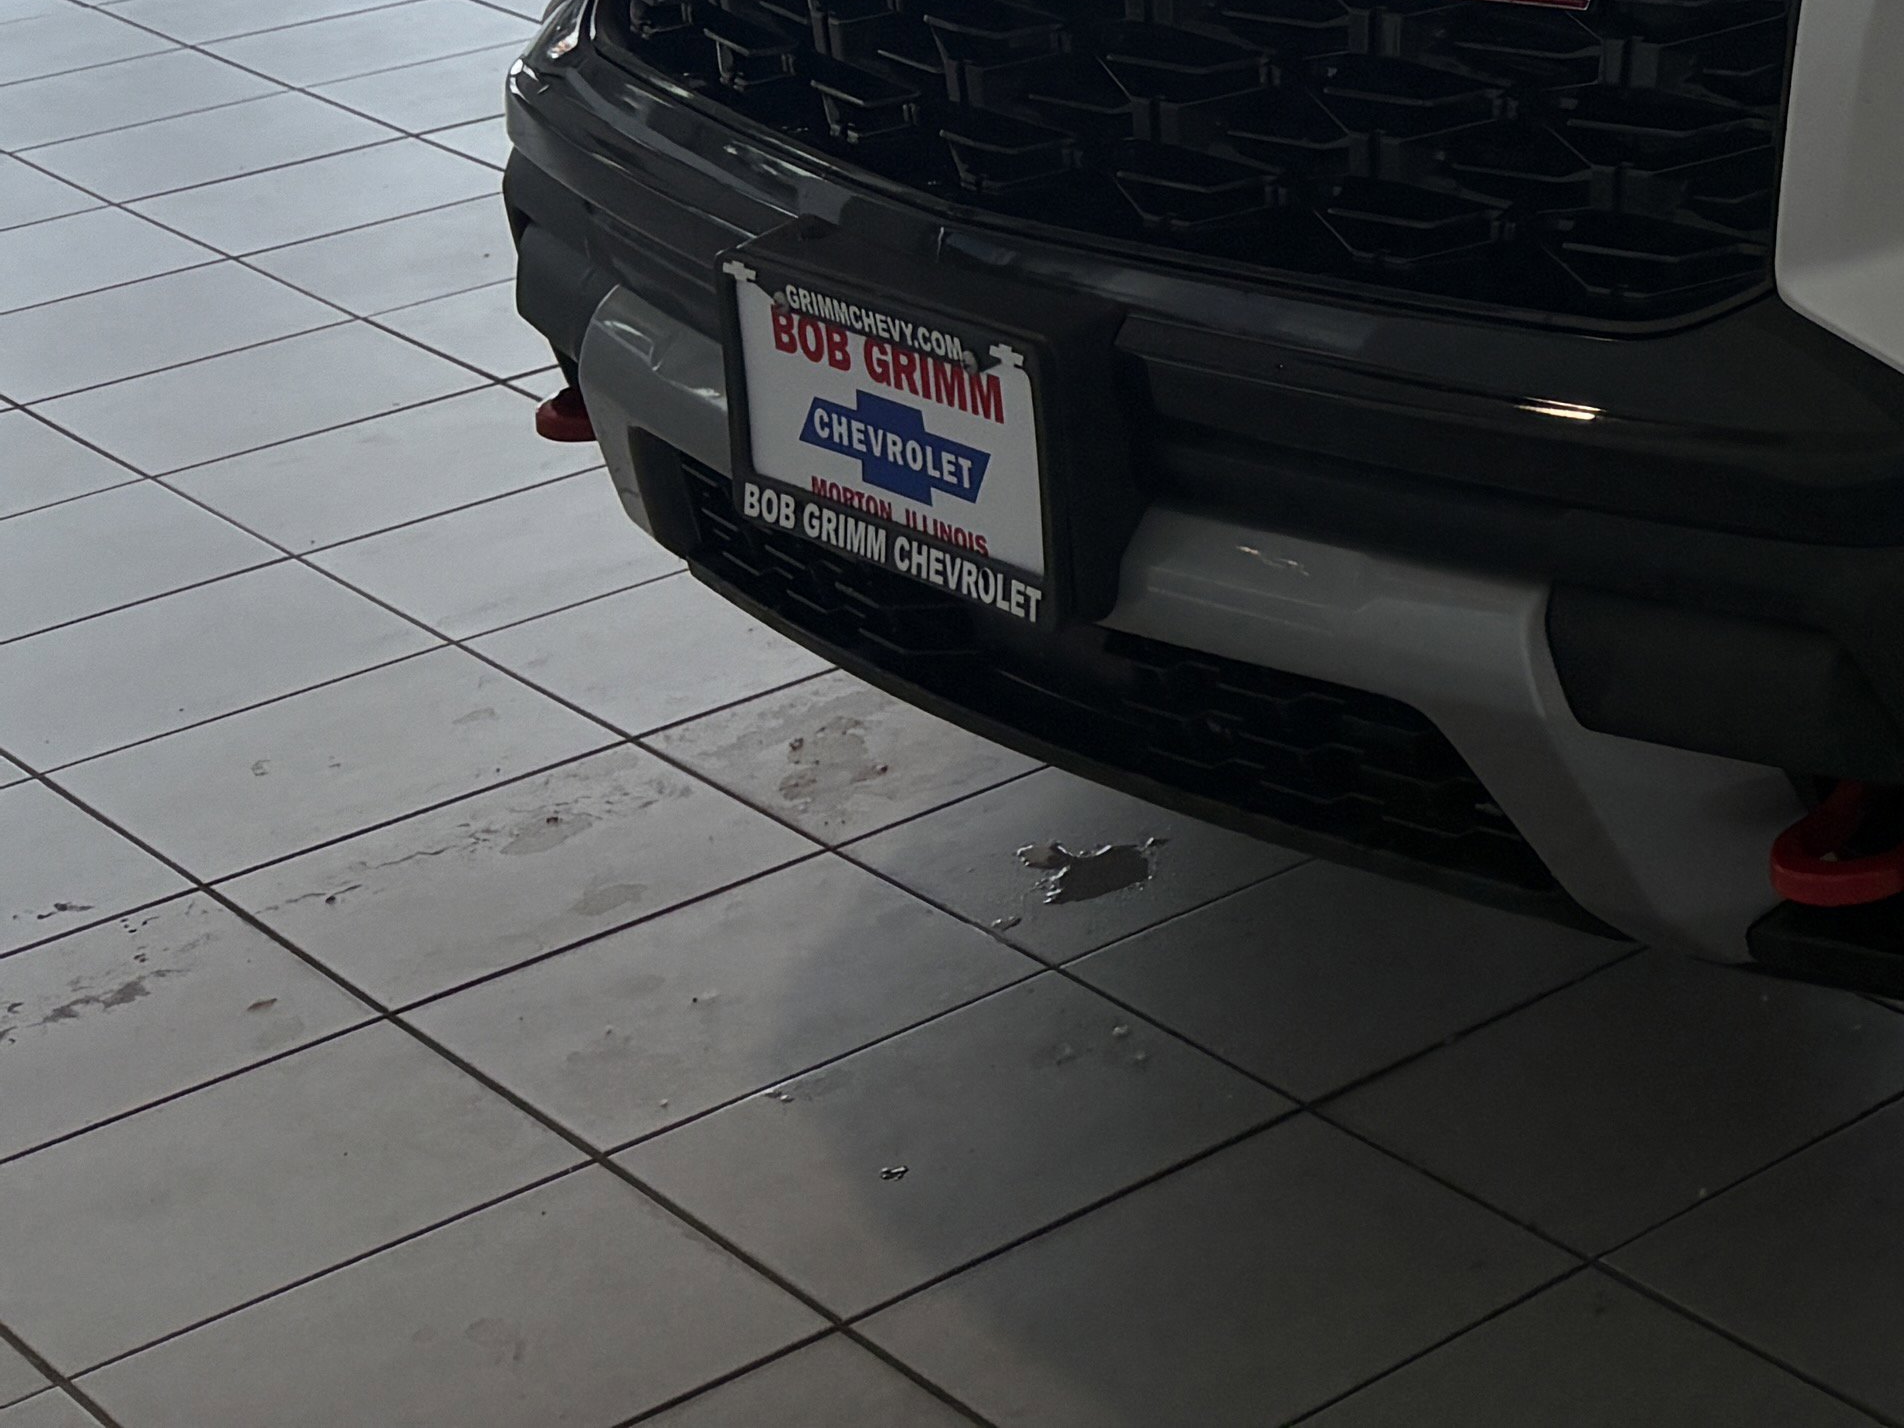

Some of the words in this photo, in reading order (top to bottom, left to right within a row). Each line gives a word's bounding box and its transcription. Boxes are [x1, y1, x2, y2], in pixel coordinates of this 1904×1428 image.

[771, 304, 852, 372] BOB
[863, 336, 1006, 424] GRIMM
[784, 284, 965, 363] GRIMMCHEVY.COM
[812, 406, 973, 492] CHEVROLET
[743, 481, 796, 530] BOB
[802, 503, 888, 565] GRIMM
[892, 536, 1042, 624] CHEVROLET
[904, 508, 990, 558] ILLINOIS
